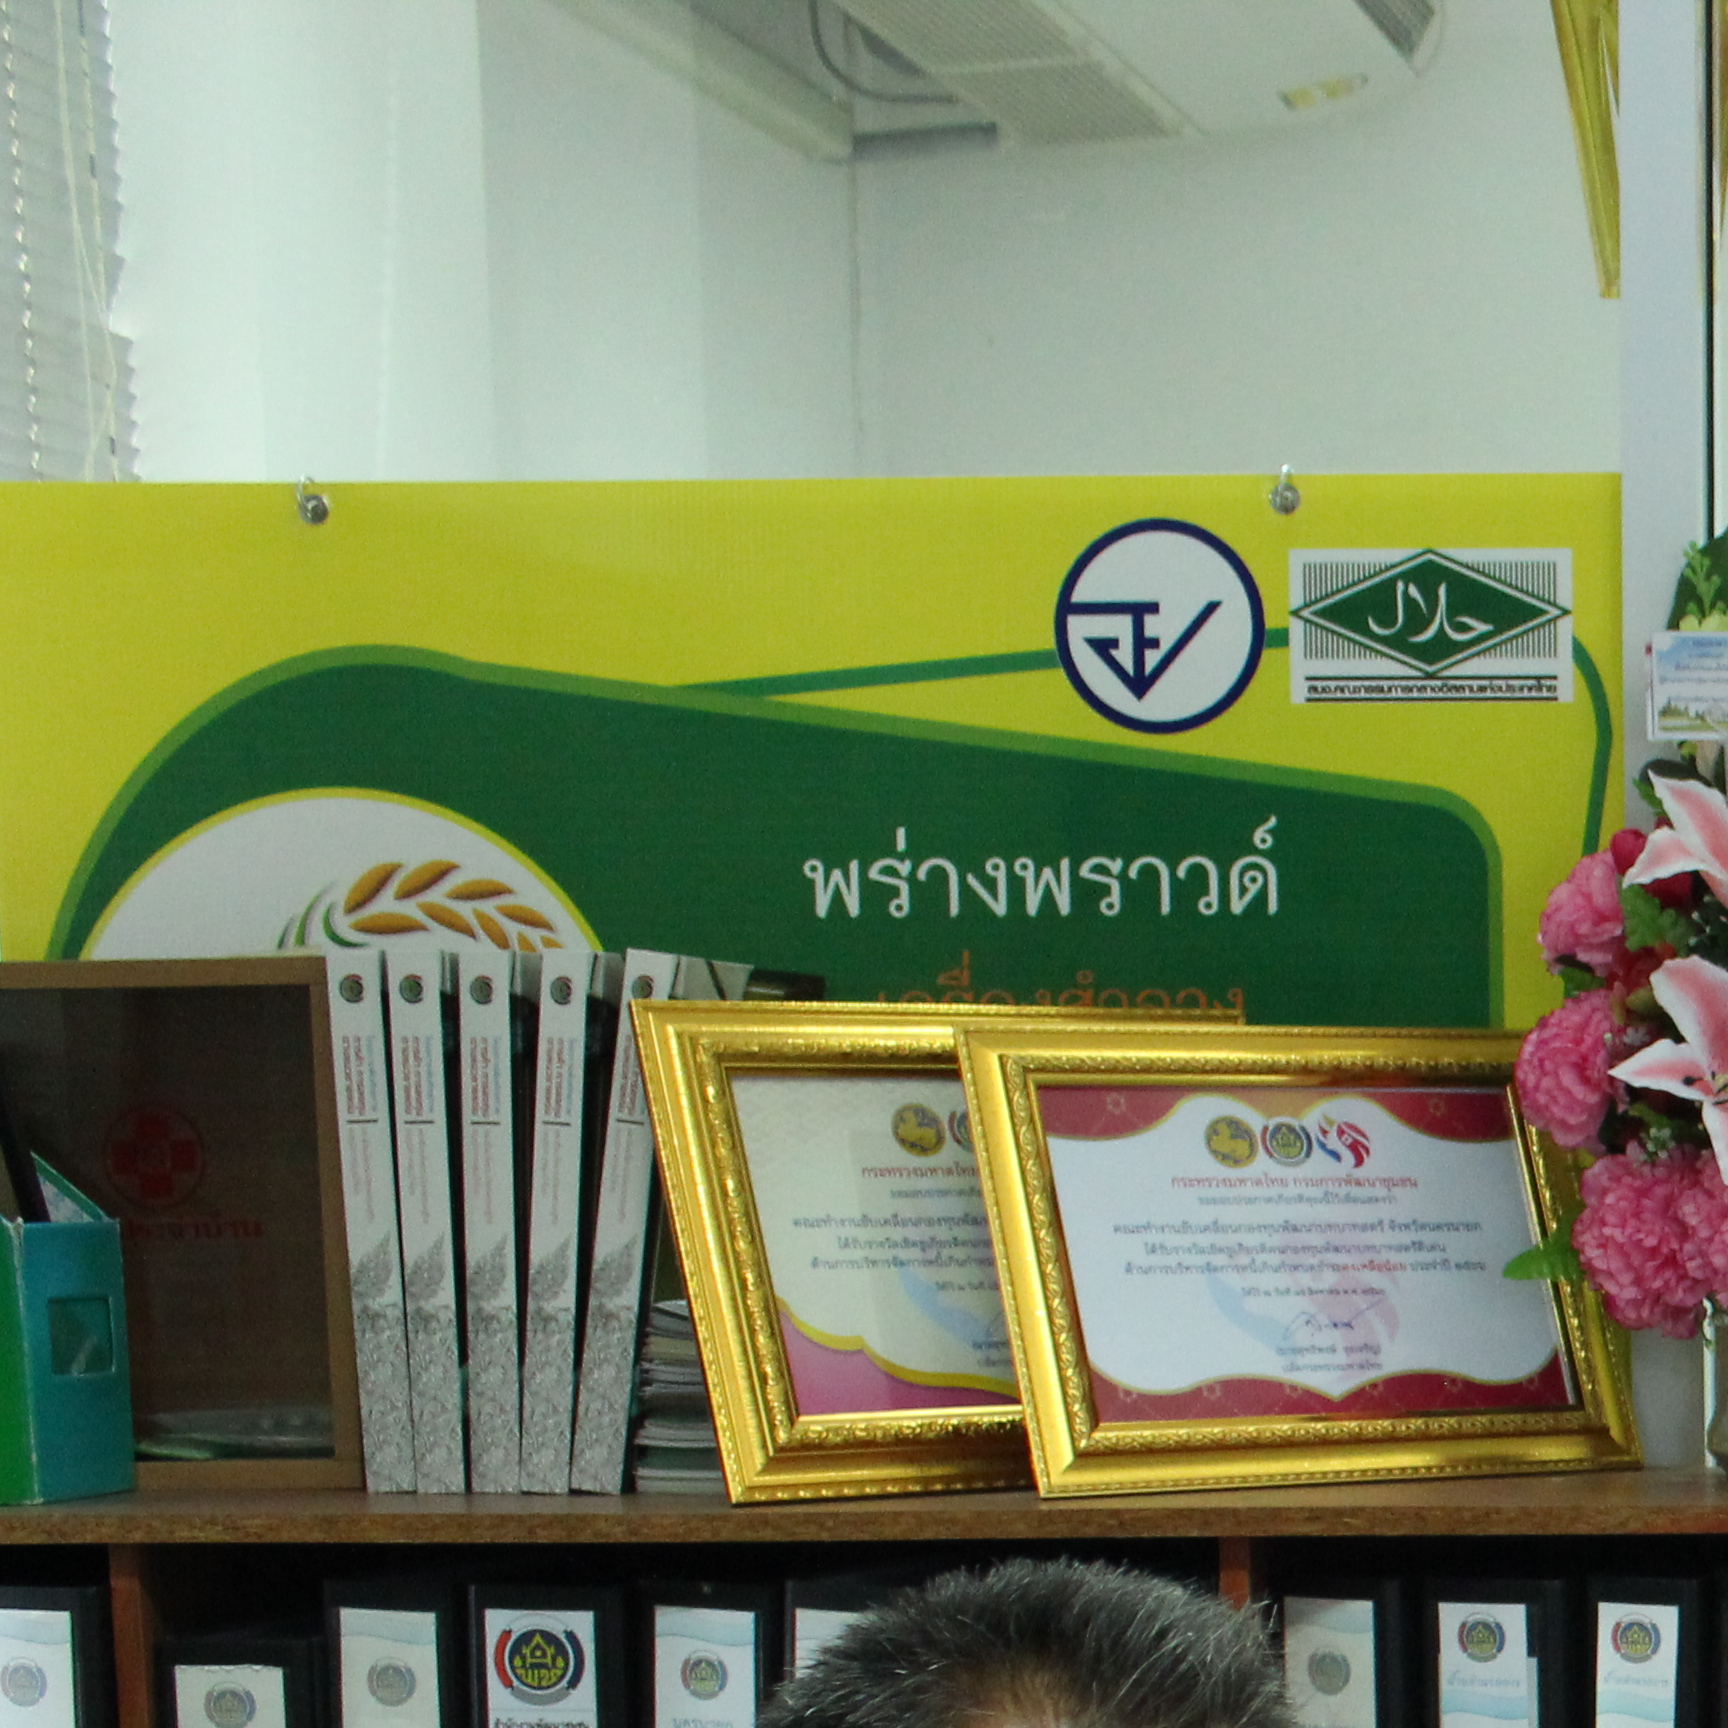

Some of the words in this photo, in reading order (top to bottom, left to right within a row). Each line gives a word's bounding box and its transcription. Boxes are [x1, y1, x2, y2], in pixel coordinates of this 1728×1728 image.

[803, 815, 1279, 918] พร่างพราวด์
